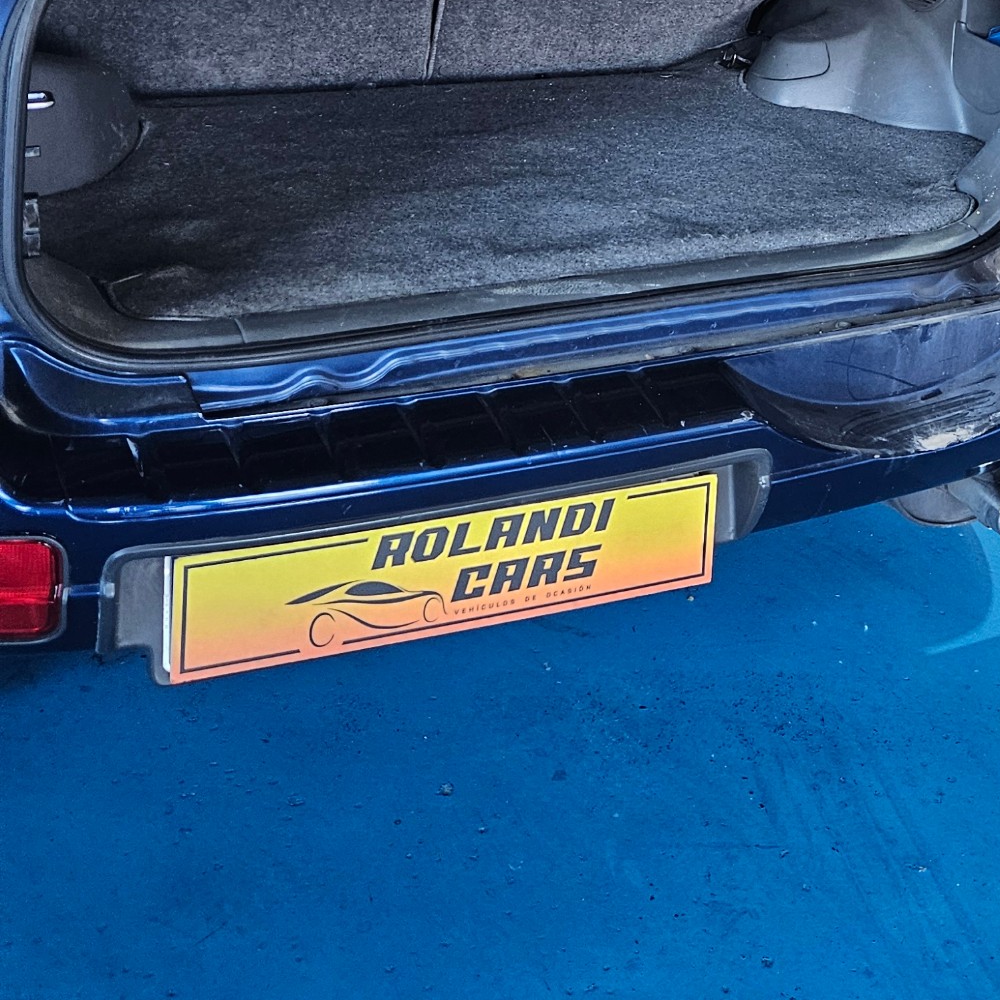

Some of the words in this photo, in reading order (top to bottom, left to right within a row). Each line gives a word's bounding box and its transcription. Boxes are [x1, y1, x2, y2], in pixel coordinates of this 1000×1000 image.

[371, 498, 616, 570] ROLANDI
[451, 544, 602, 602] CARS
[525, 594, 538, 603] DE
